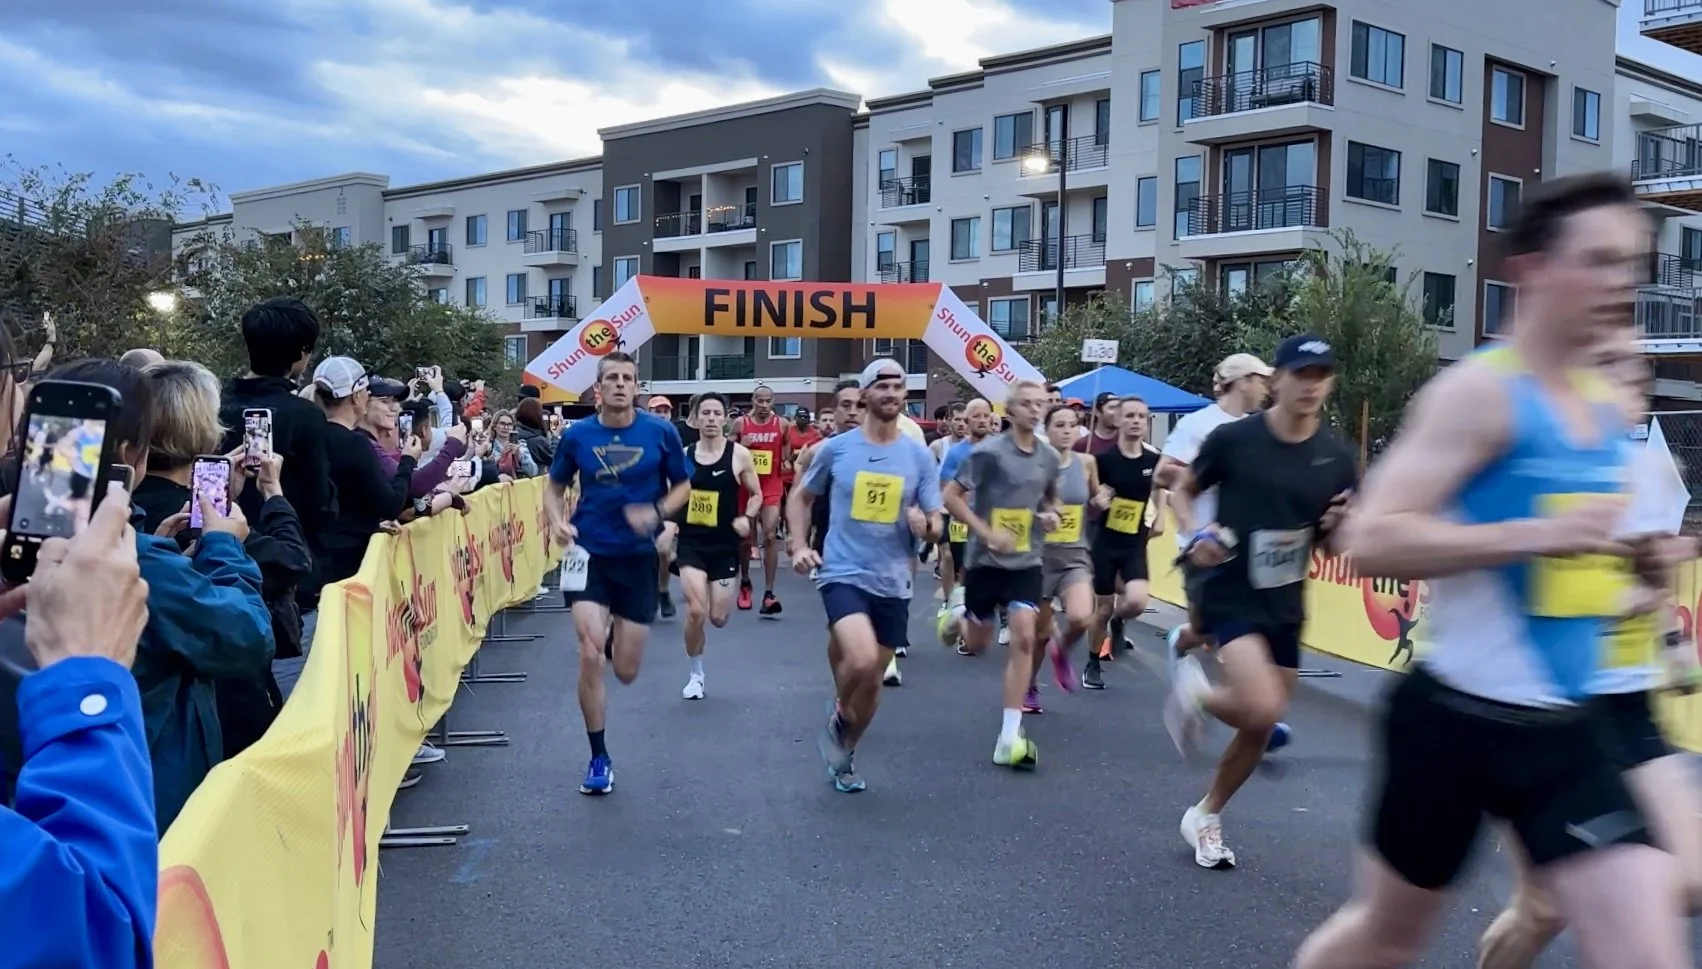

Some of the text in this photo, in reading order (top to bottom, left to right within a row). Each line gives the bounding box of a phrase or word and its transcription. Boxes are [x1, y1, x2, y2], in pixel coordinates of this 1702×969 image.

[704, 288, 876, 329] FINISH
[547, 304, 641, 380] Shun the Sun
[936, 307, 1018, 382] Shun the Su
[1087, 346, 1115, 359] 1:30
[753, 457, 768, 466] 516
[866, 489, 887, 506] 91
[691, 501, 713, 514] 289
